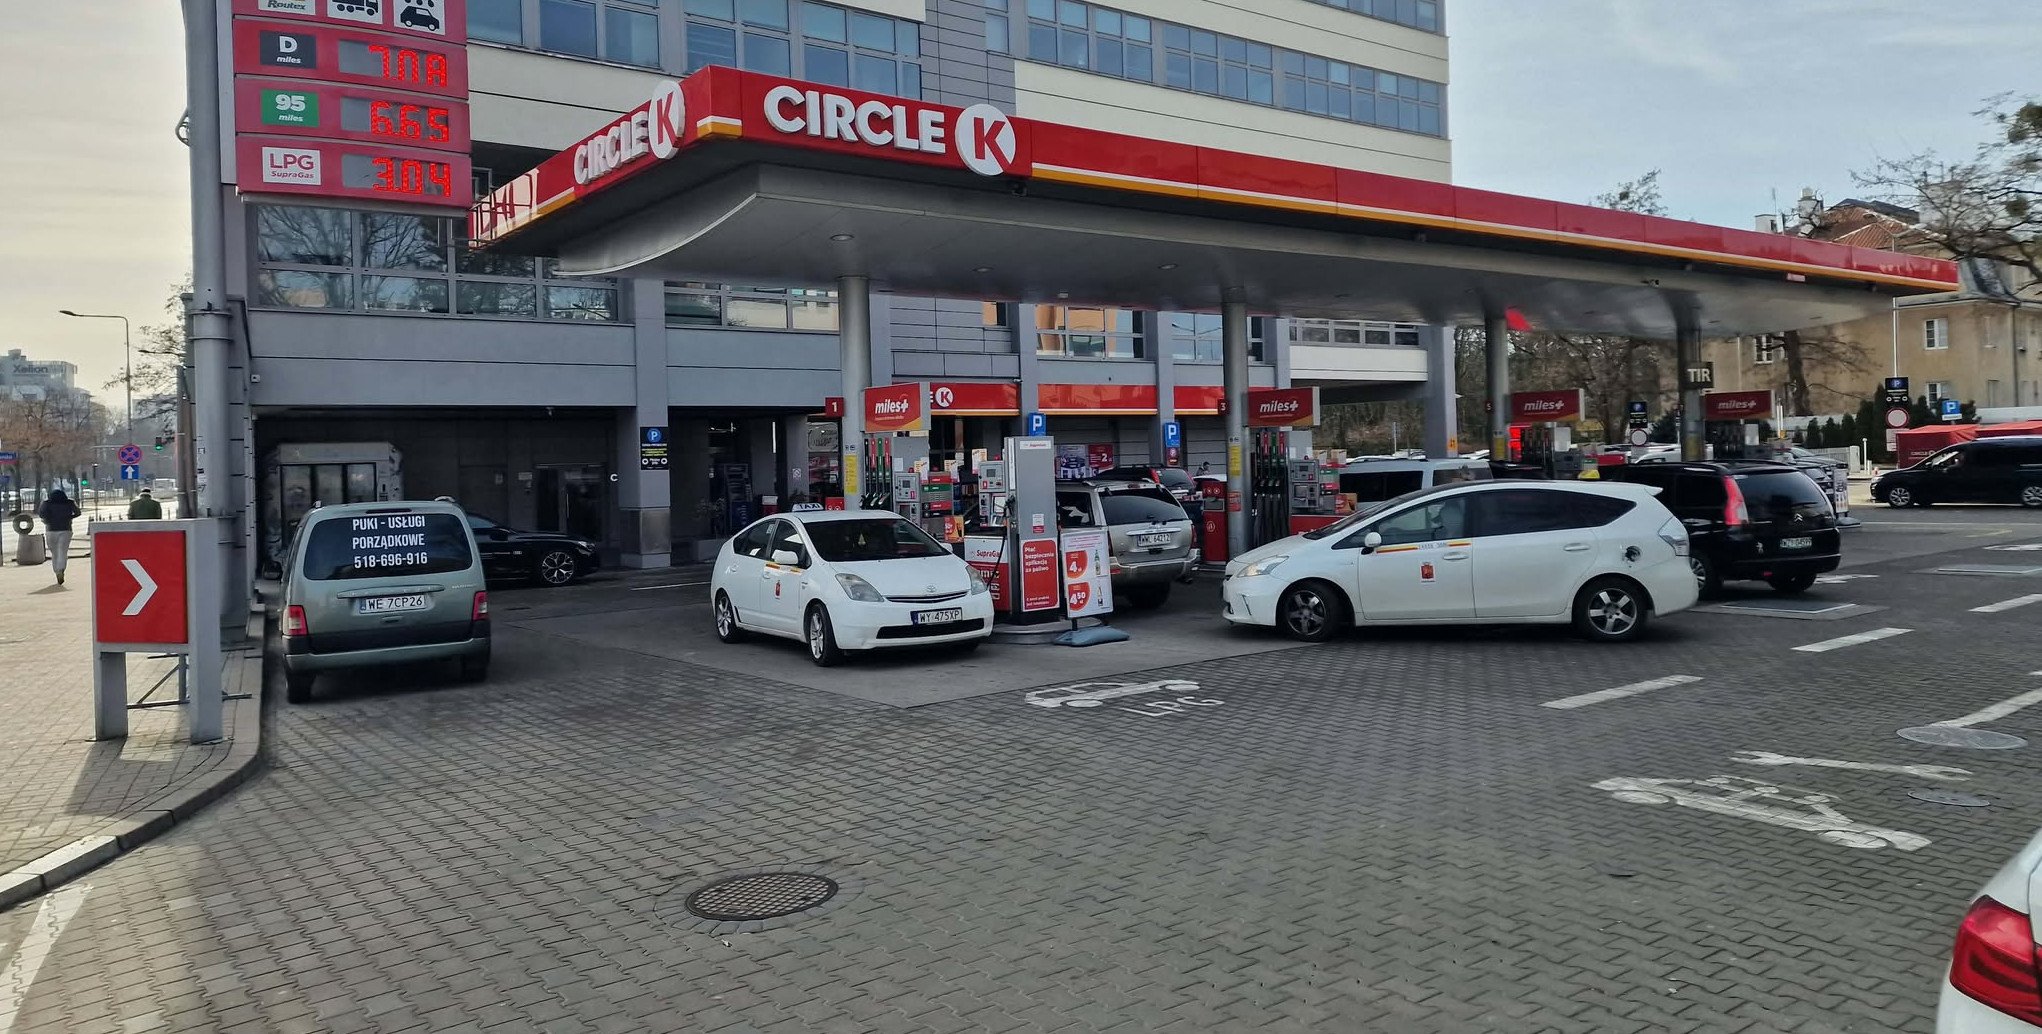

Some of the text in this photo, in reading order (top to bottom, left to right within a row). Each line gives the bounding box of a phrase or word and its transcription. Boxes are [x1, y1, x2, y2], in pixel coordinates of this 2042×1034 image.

[268, 0, 306, 10] Routex
[279, 35, 298, 53] D
[276, 56, 301, 64] miles
[275, 94, 305, 111] 95
[278, 114, 303, 122] miles
[371, 100, 450, 142] 6.65
[764, 85, 1011, 174] CIRCLE K
[574, 92, 675, 185] CIRCLE K
[269, 153, 314, 170] LPG
[271, 170, 314, 179] SupraGas
[372, 157, 451, 197] 3.04
[1687, 368, 1710, 383] TIR
[832, 401, 838, 412] 1
[1220, 402, 1226, 411] 3
[1946, 402, 1956, 412] P
[1032, 417, 1043, 431] P
[651, 431, 658, 441] P
[1168, 424, 1177, 439] P
[1101, 453, 1108, 462] 2
[352, 517, 378, 531] PUKI
[388, 515, 426, 529] USŁUGI
[352, 533, 425, 550] PORZĄDKOWE
[354, 552, 428, 568] 518-696-916
[976, 549, 1000, 558] SupraGa
[368, 597, 423, 610] WE 7CP26
[919, 610, 960, 623] WY 475XP
[1119, 696, 1225, 717] LPG
